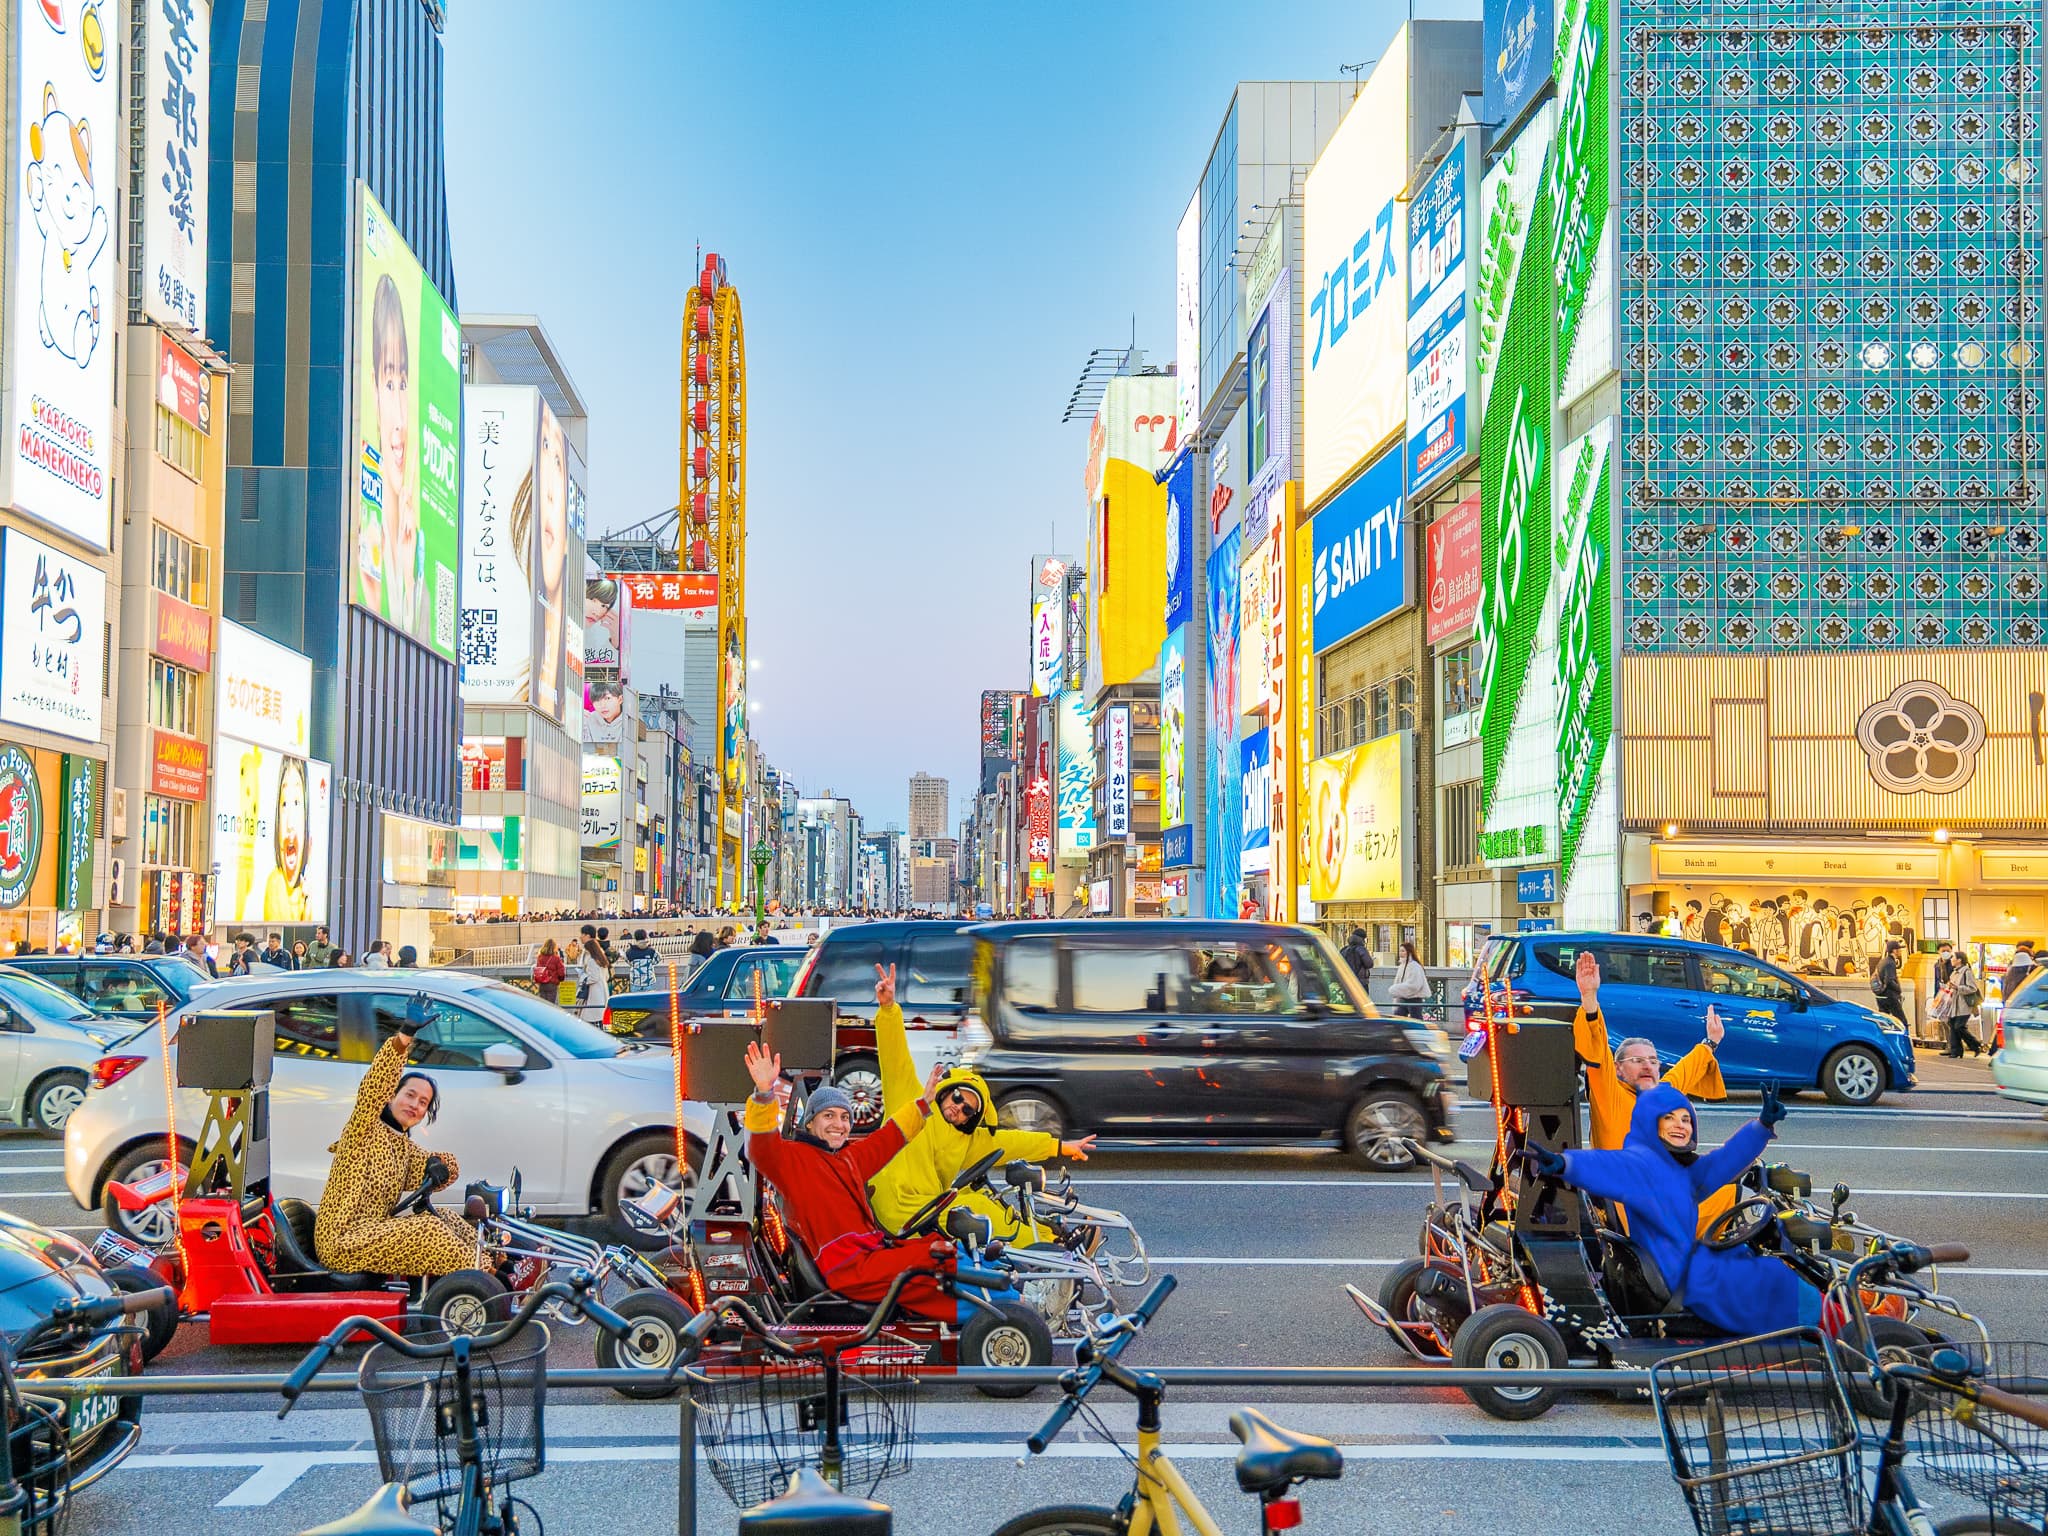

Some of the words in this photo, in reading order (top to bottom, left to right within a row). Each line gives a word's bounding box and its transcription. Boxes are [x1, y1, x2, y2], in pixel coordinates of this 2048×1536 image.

[1310, 196, 1397, 372] プロミス
[1413, 362, 1430, 399] AGA
[38, 402, 87, 449] KARAOKE
[20, 427, 102, 495] MANEKINEKO
[1331, 499, 1401, 593] SAMTY
[633, 583, 654, 600] 免
[662, 583, 681, 600] 税
[684, 588, 697, 596] Tax
[699, 588, 715, 596] Free
[160, 608, 185, 649] LONG
[187, 620, 209, 657] DINH
[227, 672, 283, 728] なの花薬局
[10, 748, 32, 787] Pork
[157, 740, 181, 763] LONG
[181, 744, 204, 769] DINH
[1113, 773, 1126, 831] かに道楽
[70, 777, 84, 911] 美味しさがある
[1824, 861, 1847, 869] Bread
[2011, 864, 2028, 872] Brot
[719, 1280, 748, 1291] Castrol
